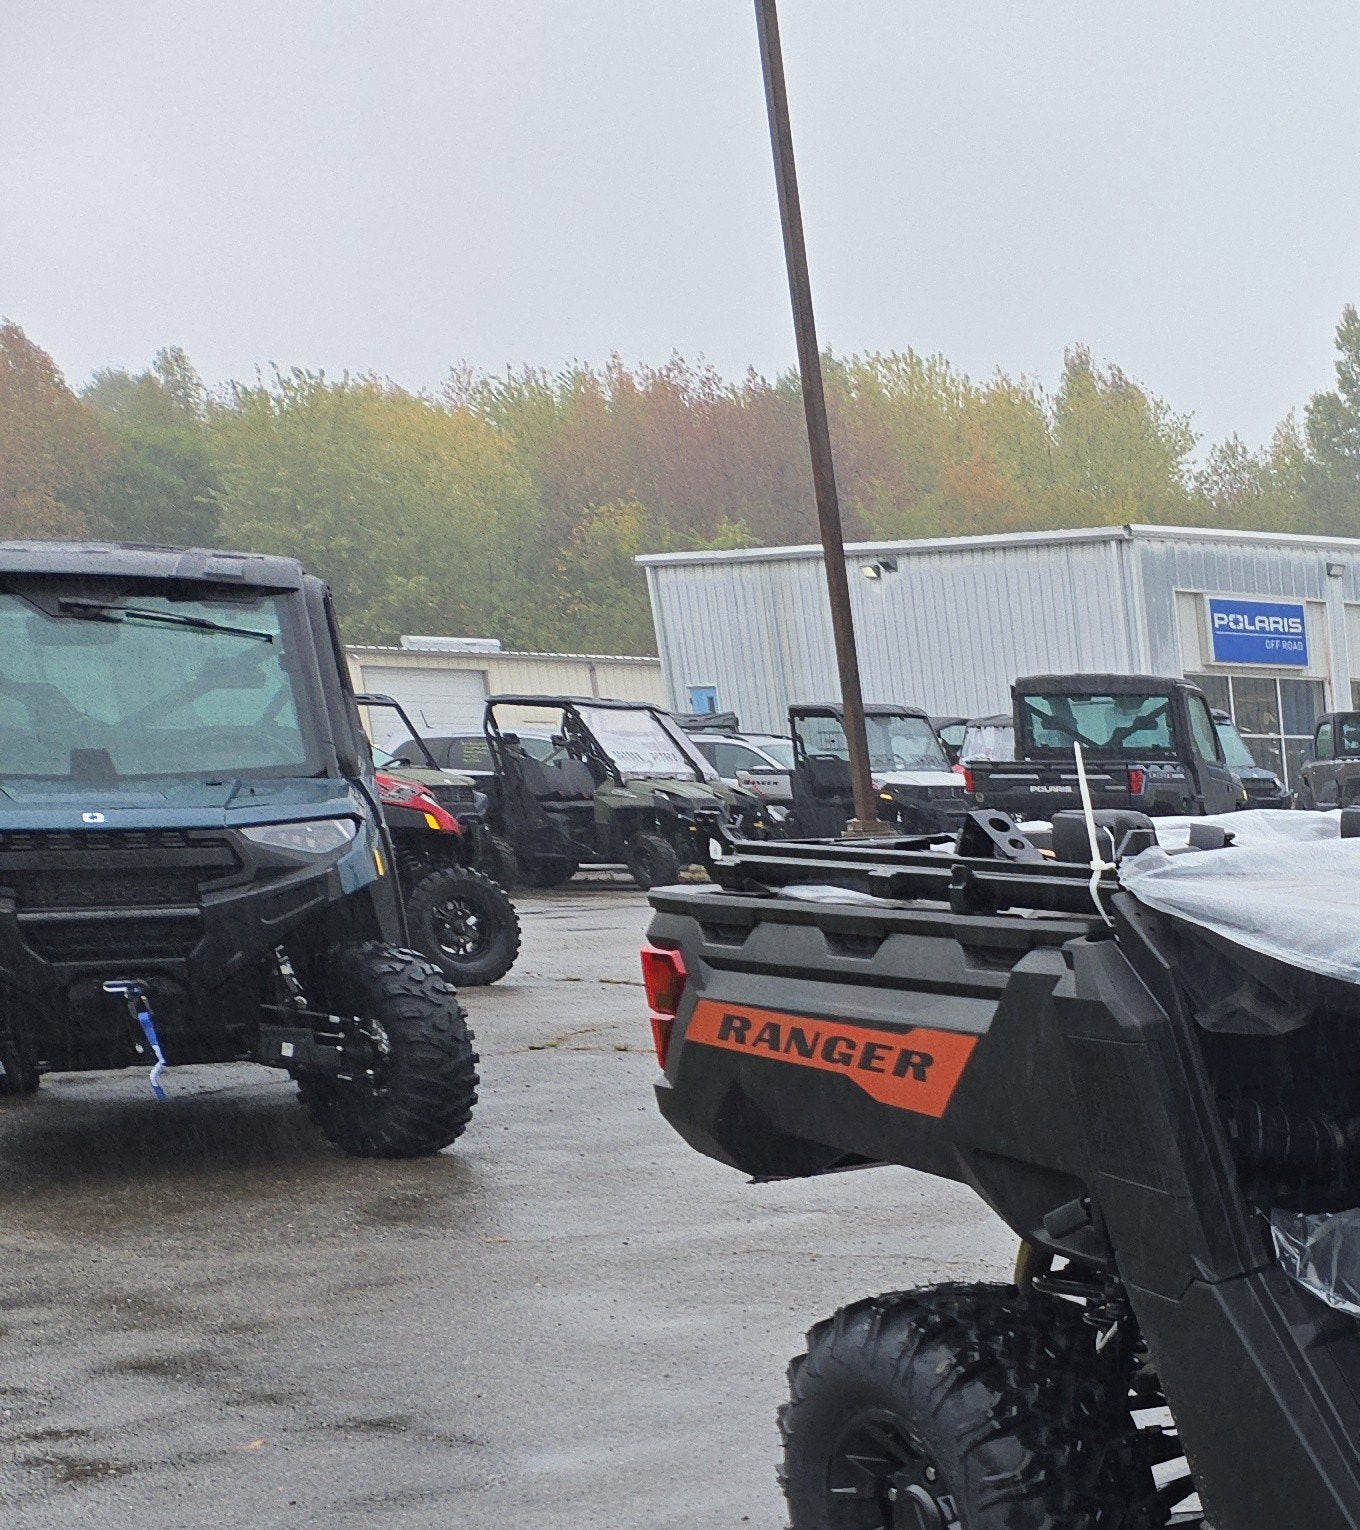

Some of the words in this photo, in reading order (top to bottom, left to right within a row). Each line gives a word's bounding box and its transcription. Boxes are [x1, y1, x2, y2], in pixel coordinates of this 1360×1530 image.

[1213, 612, 1302, 633] POLARIS
[1265, 639, 1281, 650] OFF
[1282, 640, 1304, 651] ROAD
[1030, 785, 1072, 793] POLARIS
[717, 1012, 935, 1083] RANGER
